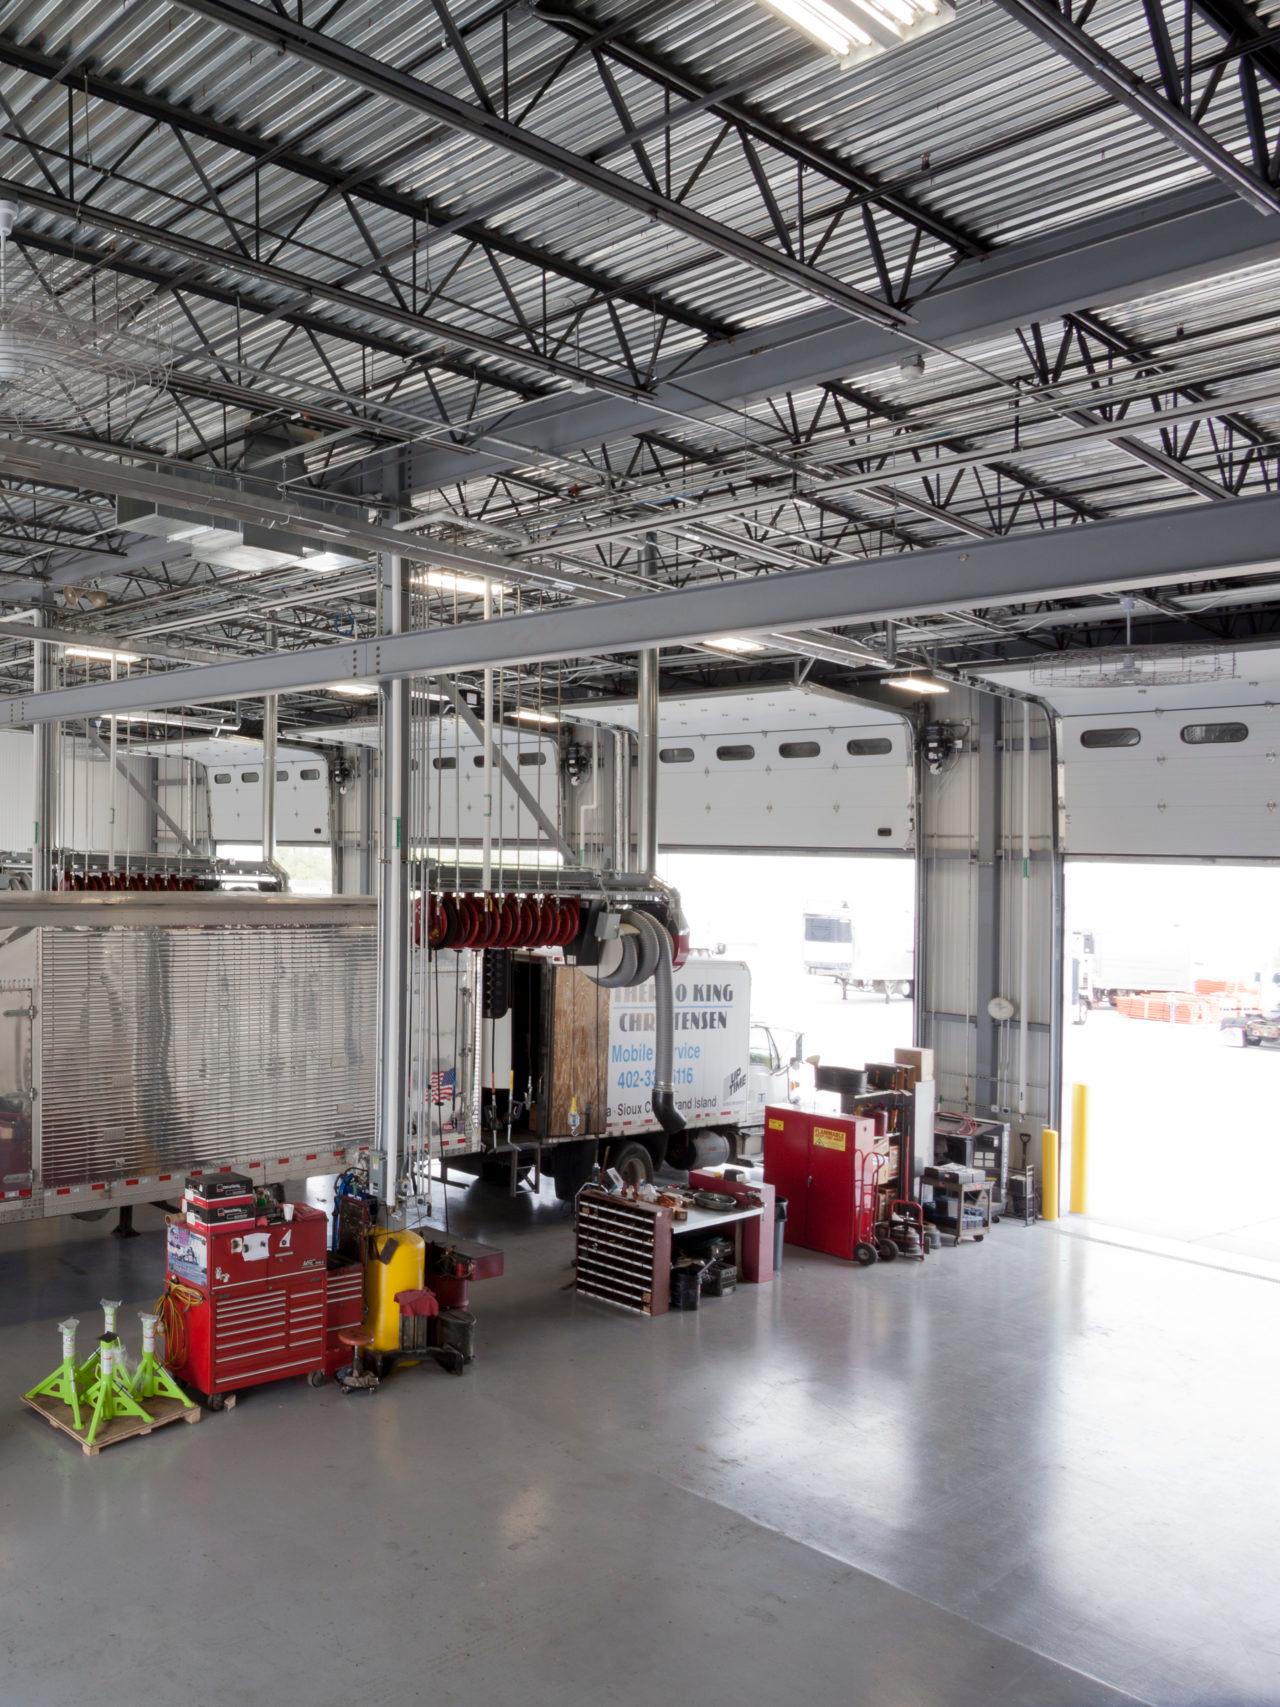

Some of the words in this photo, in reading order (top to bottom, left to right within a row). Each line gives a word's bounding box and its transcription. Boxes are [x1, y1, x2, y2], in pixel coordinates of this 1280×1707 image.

[615, 984, 687, 1002] THEO
[693, 983, 734, 1002] KING
[619, 1011, 727, 1032] CHRTENSEN
[612, 1043, 653, 1063] Mobile
[729, 1074, 746, 1096] TIME
[730, 1067, 741, 1083] UP
[617, 1103, 642, 1116] Sioux
[694, 1096, 717, 1108] Island
